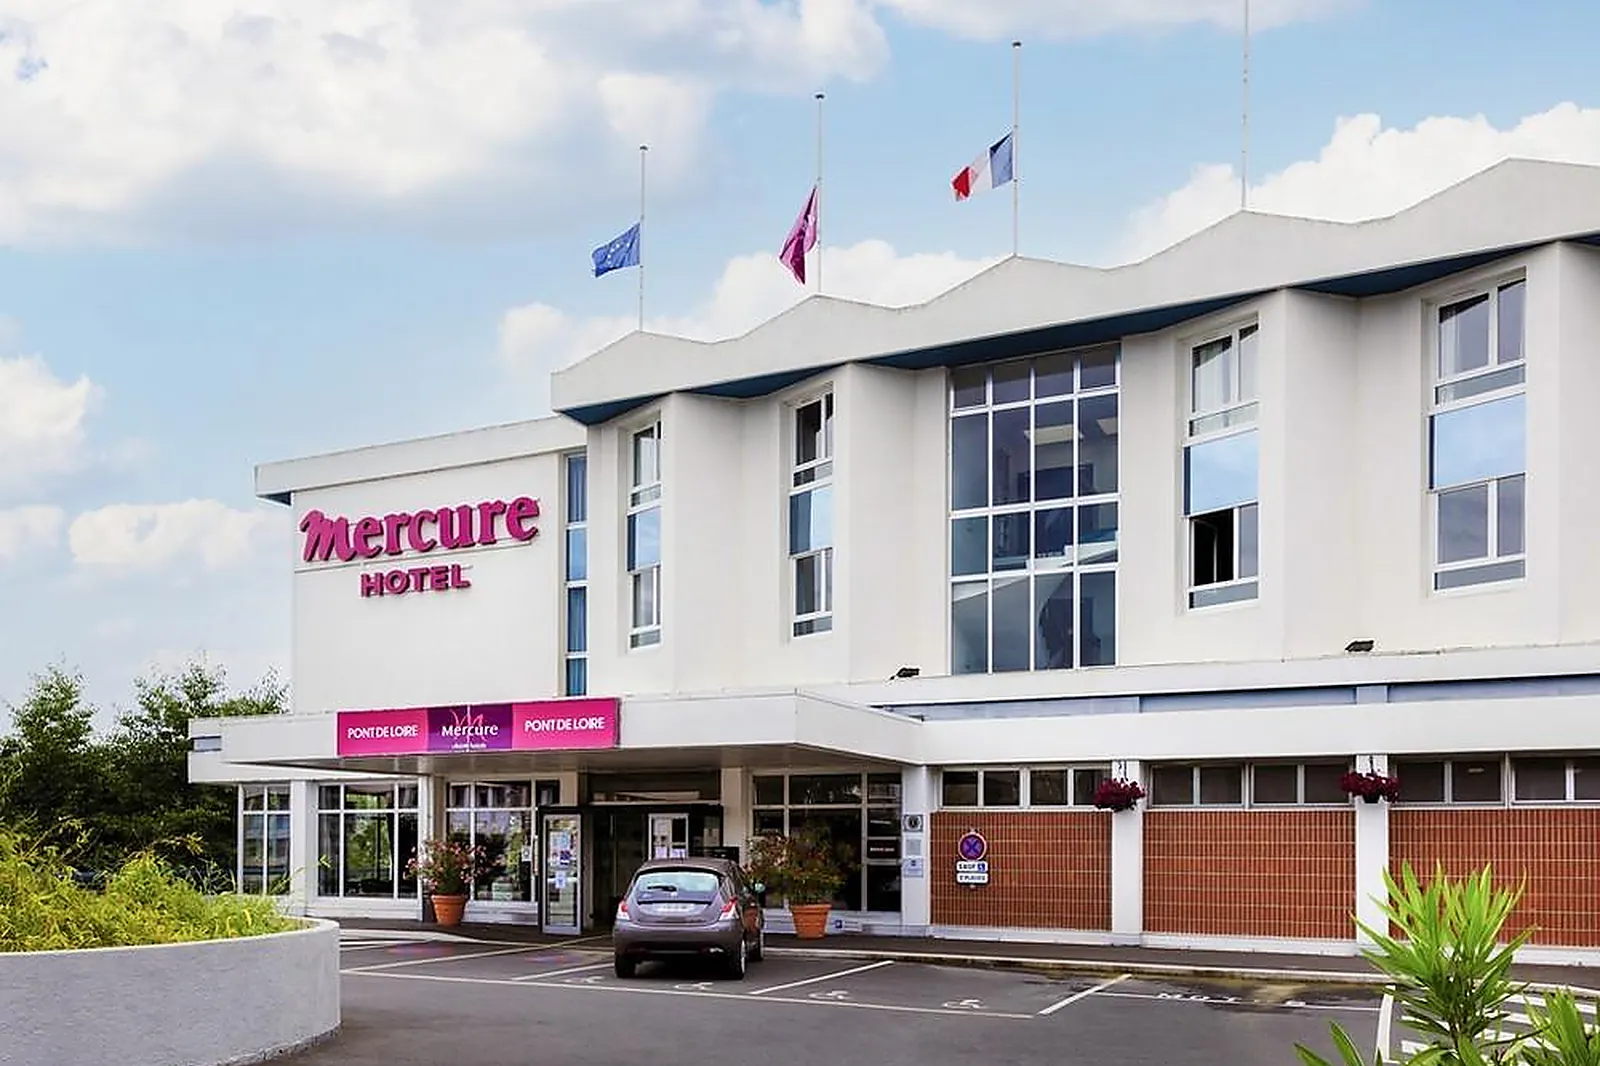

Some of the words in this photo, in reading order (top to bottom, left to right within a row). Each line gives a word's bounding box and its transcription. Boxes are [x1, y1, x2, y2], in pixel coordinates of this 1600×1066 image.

[360, 564, 471, 597] HOTEL
[347, 726, 375, 739] PONT
[375, 726, 389, 738] DE
[390, 724, 419, 737] LOIRE
[441, 724, 499, 737] Mercure
[524, 719, 555, 732] PONT
[556, 717, 572, 731] DE
[573, 716, 605, 730] LOIRE
